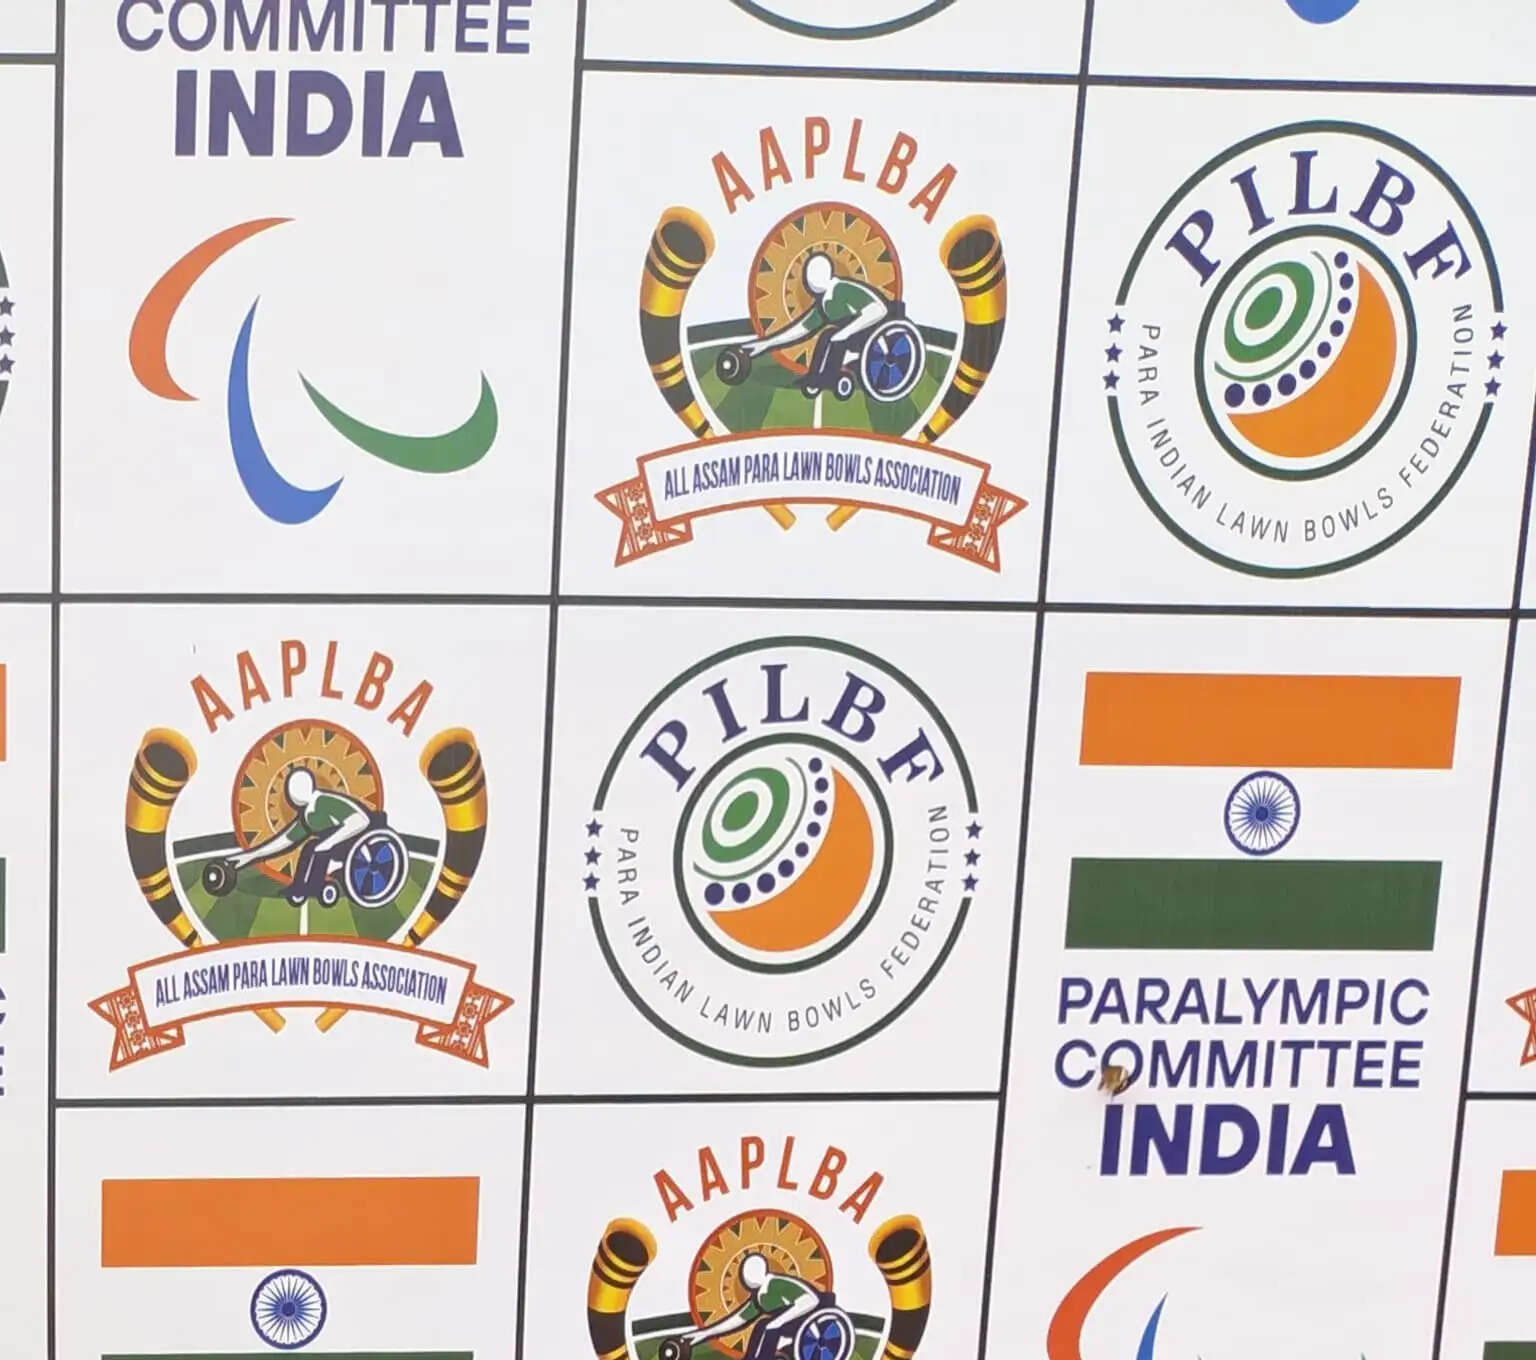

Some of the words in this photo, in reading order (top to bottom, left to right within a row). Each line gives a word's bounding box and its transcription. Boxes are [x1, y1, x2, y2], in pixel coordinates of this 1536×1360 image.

[117, 0, 532, 53] COMMITTEE
[176, 70, 464, 157] INDIA
[712, 117, 957, 225] AAPLBA
[1164, 151, 1472, 286] PILBF
[1140, 324, 1161, 405] PARA
[1399, 304, 1474, 488] FEDERATION
[666, 468, 689, 500] ALL
[694, 457, 740, 493] ASSAM
[745, 453, 779, 483] PARA
[783, 452, 821, 481] LAWN
[826, 453, 871, 483] BOWLS
[874, 459, 962, 505] ASSOCIATION
[1147, 419, 1210, 510] INDIAN
[1217, 503, 1289, 542] LAWN
[1306, 487, 1394, 542] BOWLS
[192, 639, 434, 738] AAPLBA
[639, 664, 945, 792] PILBF
[619, 828, 639, 905] PARA
[880, 805, 950, 979] FEDERATION
[157, 976, 180, 1007] ALL
[184, 964, 229, 999] ASSAM
[234, 960, 267, 989] PARA
[272, 957, 308, 986] LAWN
[314, 958, 358, 985] BOWLS
[361, 962, 448, 1004] ASSOCIATION
[628, 917, 693, 1003] INDIAN
[700, 996, 772, 1033] LAWN
[789, 978, 876, 1032] BOWLS
[1059, 978, 1429, 1025] PARALYMPIC
[1055, 1040, 1423, 1091] COMMITTEE
[1101, 1104, 1355, 1176] INDIA
[654, 1135, 885, 1225] AAPLBA
